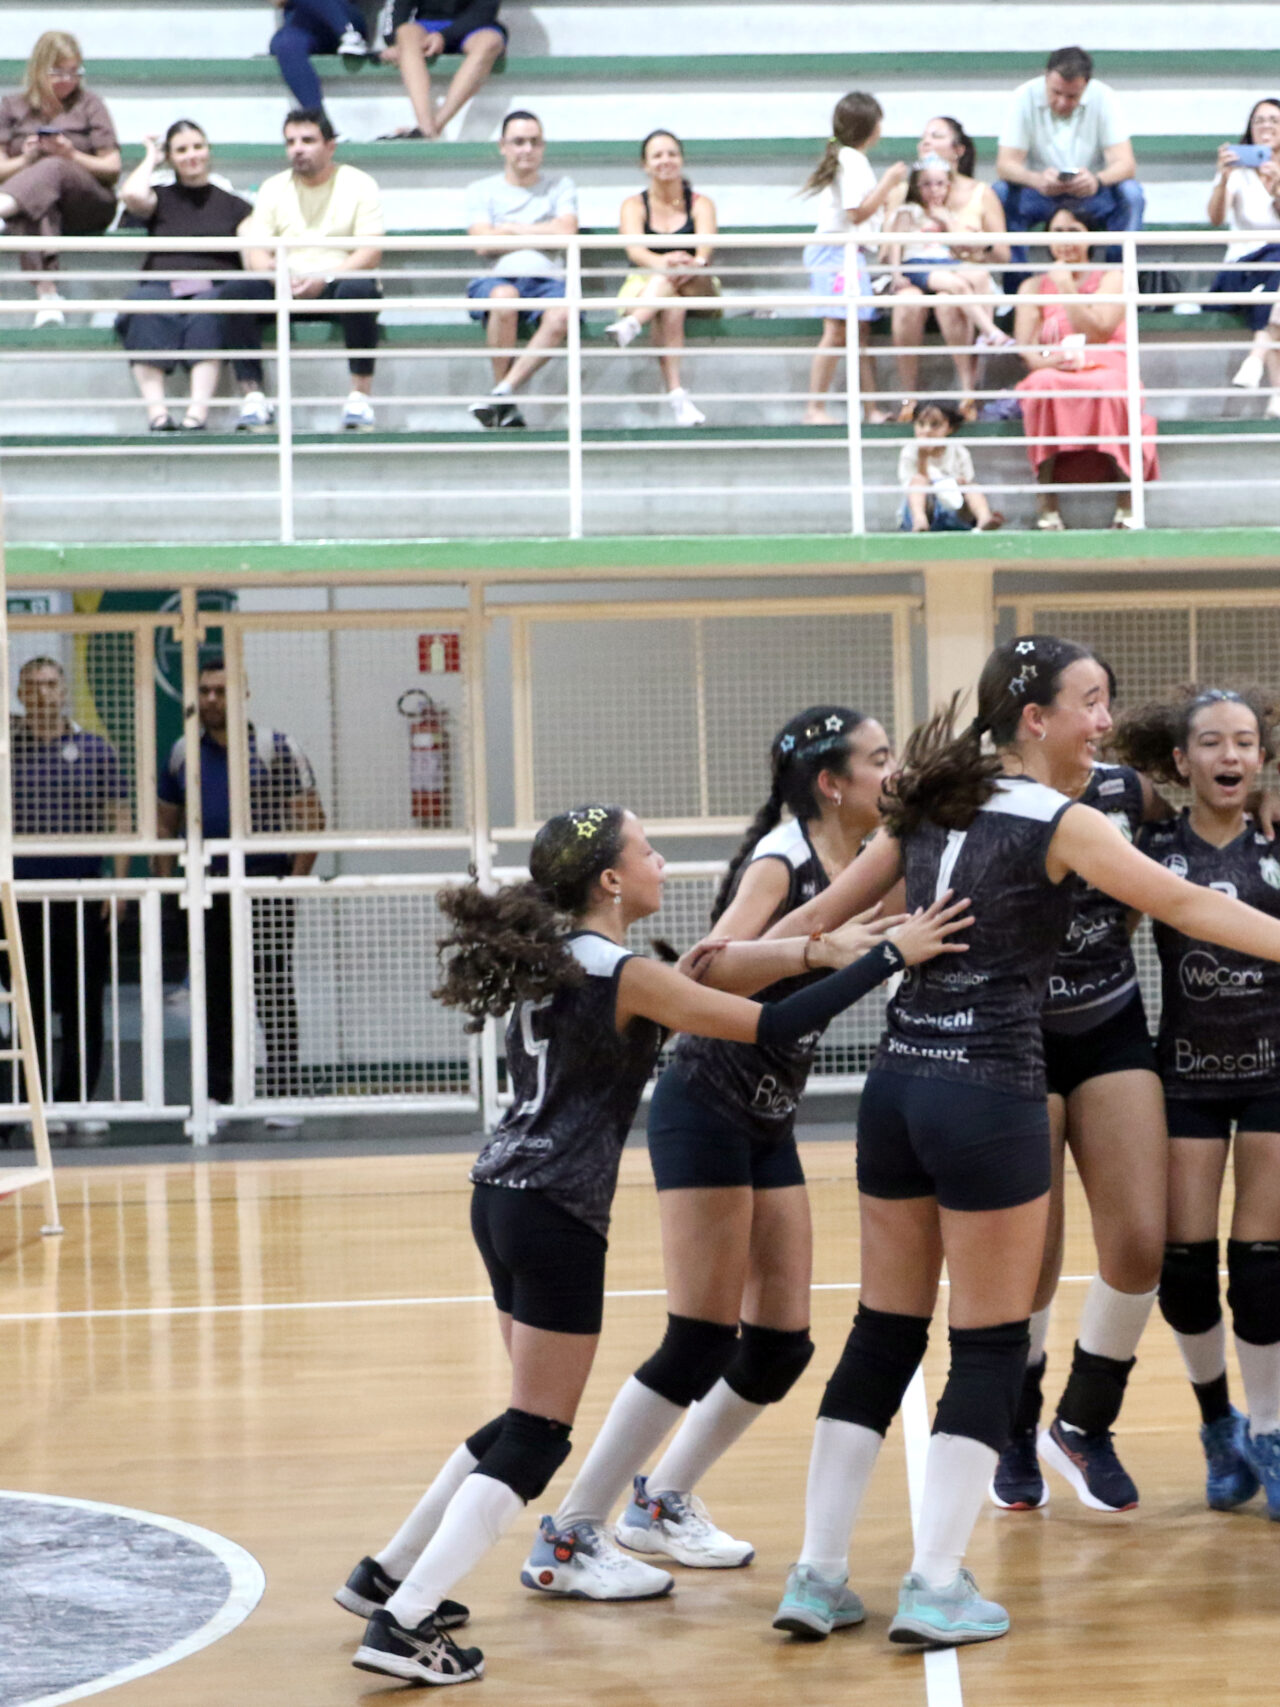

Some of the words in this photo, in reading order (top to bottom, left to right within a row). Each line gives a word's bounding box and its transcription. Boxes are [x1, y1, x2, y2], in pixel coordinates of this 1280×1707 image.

[934, 828, 968, 902] 1
[1183, 965, 1264, 986] WeCare
[517, 993, 554, 1117] 5
[1175, 1037, 1276, 1073] Biosalli
